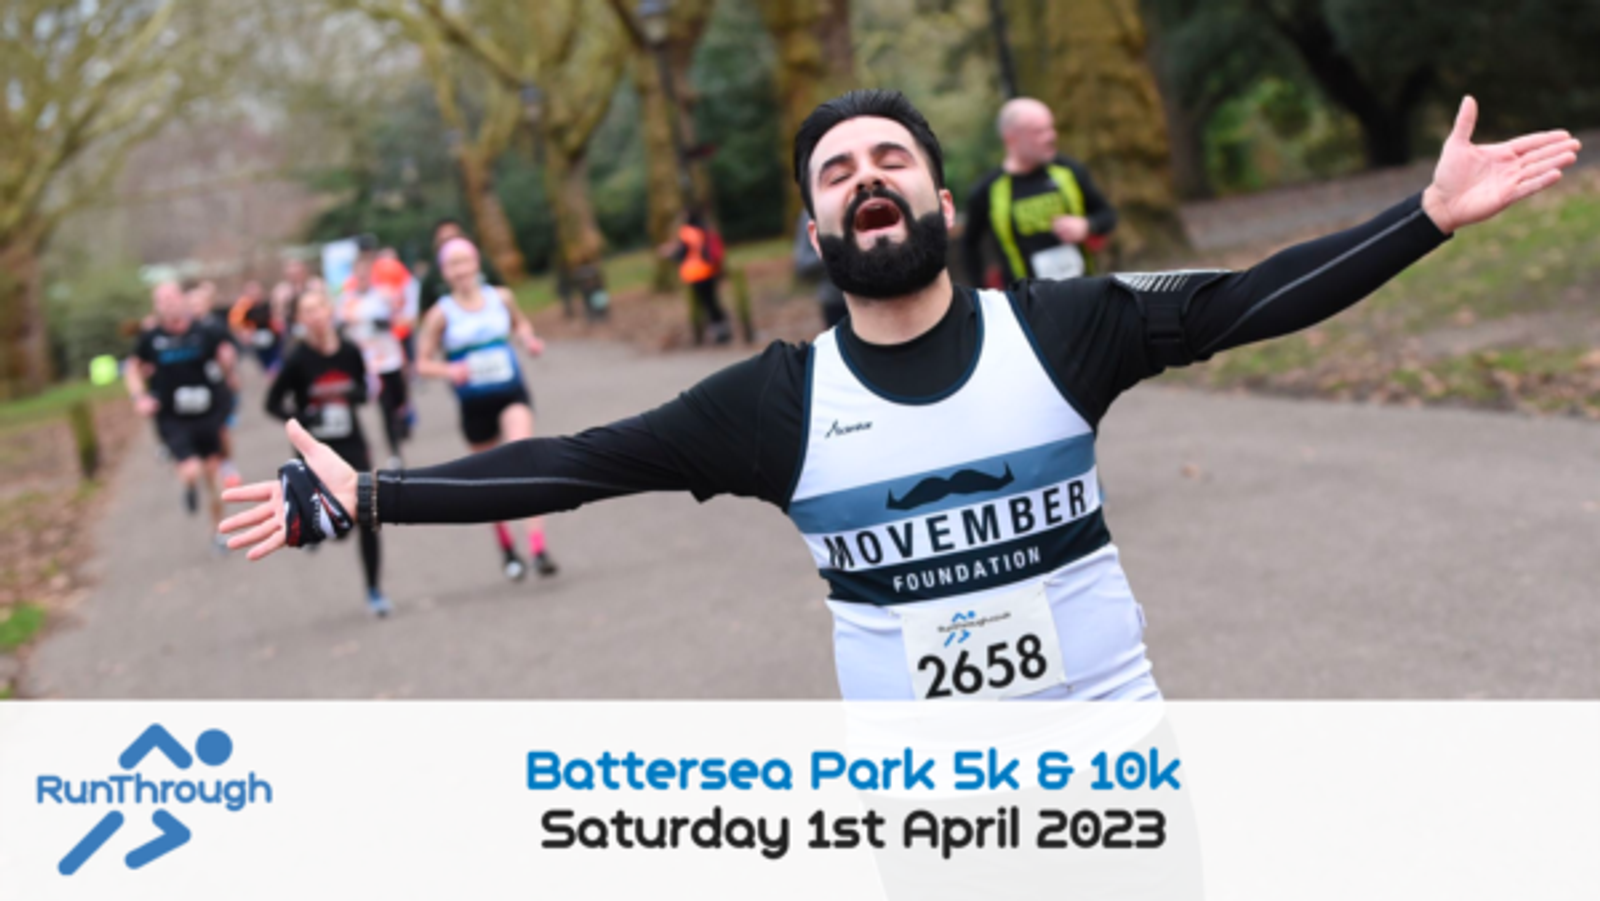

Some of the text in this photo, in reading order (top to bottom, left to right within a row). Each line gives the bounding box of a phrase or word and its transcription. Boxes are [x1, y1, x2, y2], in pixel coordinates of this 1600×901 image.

[824, 480, 1089, 571] MOVEMBER
[892, 546, 1042, 593] FOUNDATION
[917, 633, 1048, 700] 2658
